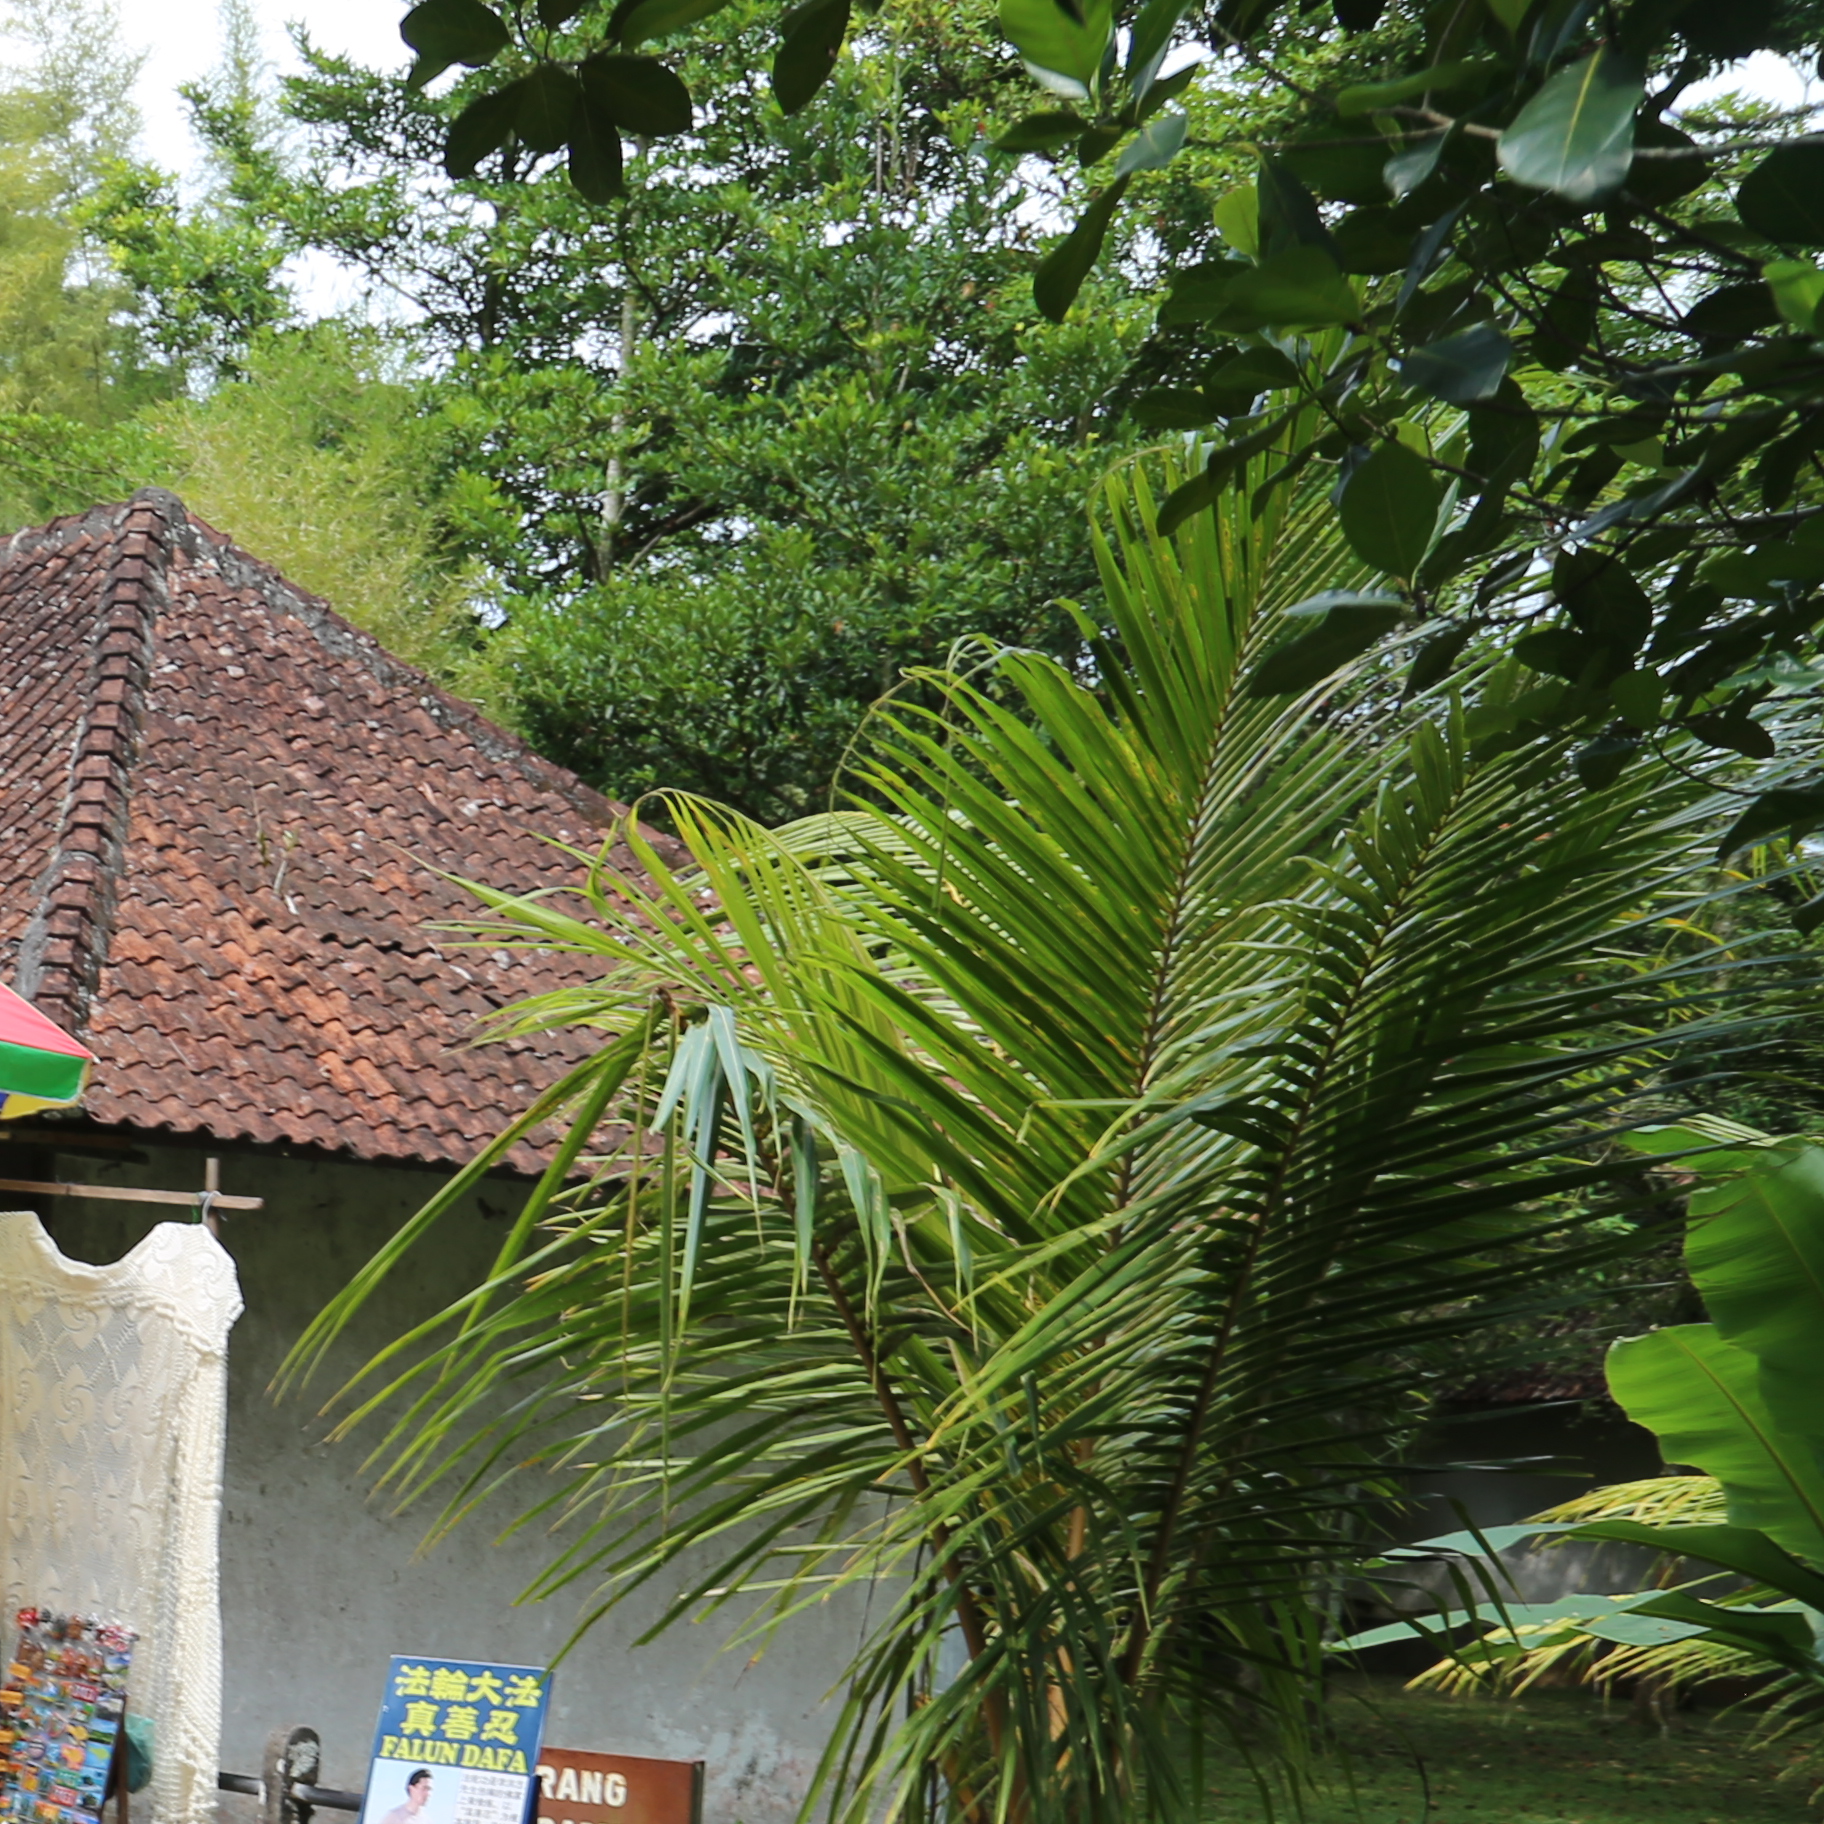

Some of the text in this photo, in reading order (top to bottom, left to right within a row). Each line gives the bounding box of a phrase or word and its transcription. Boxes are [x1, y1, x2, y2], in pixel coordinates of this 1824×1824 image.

[394, 1664, 544, 1708] 法輪大法
[399, 1700, 521, 1746] 真善忍
[379, 1735, 529, 1774] FALUN DAFA
